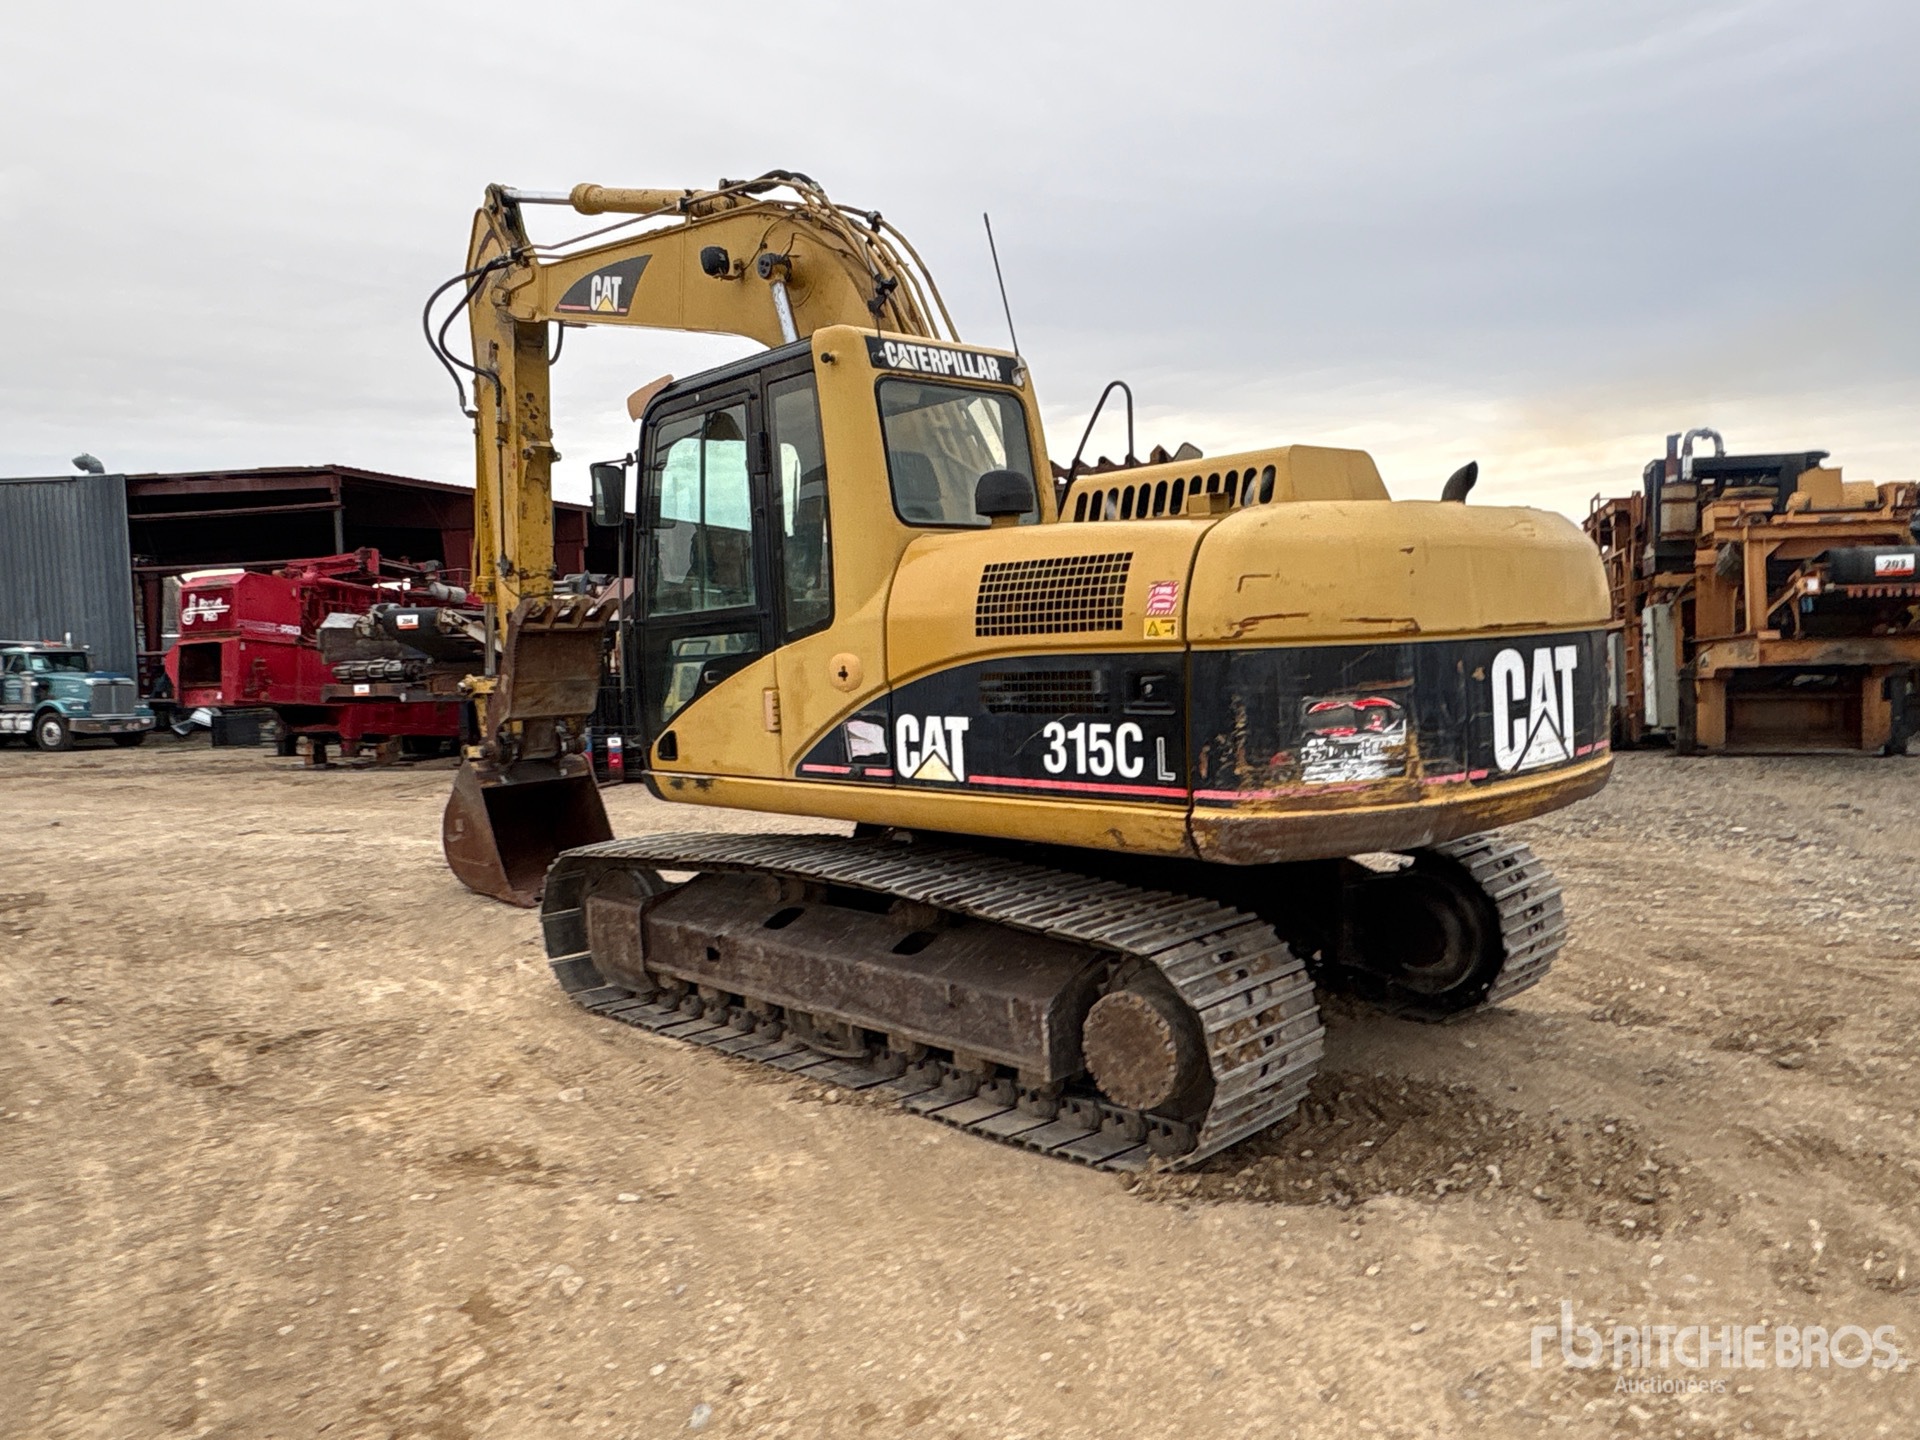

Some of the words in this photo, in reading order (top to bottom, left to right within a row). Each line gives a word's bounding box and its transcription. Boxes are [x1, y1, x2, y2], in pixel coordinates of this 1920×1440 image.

[590, 274, 623, 312] CAT
[883, 341, 1002, 382] CATERPILLAR
[1491, 644, 1578, 772] CAT
[895, 713, 970, 783] CAT
[1042, 721, 1144, 779] 315C
[1156, 736, 1176, 781] L
